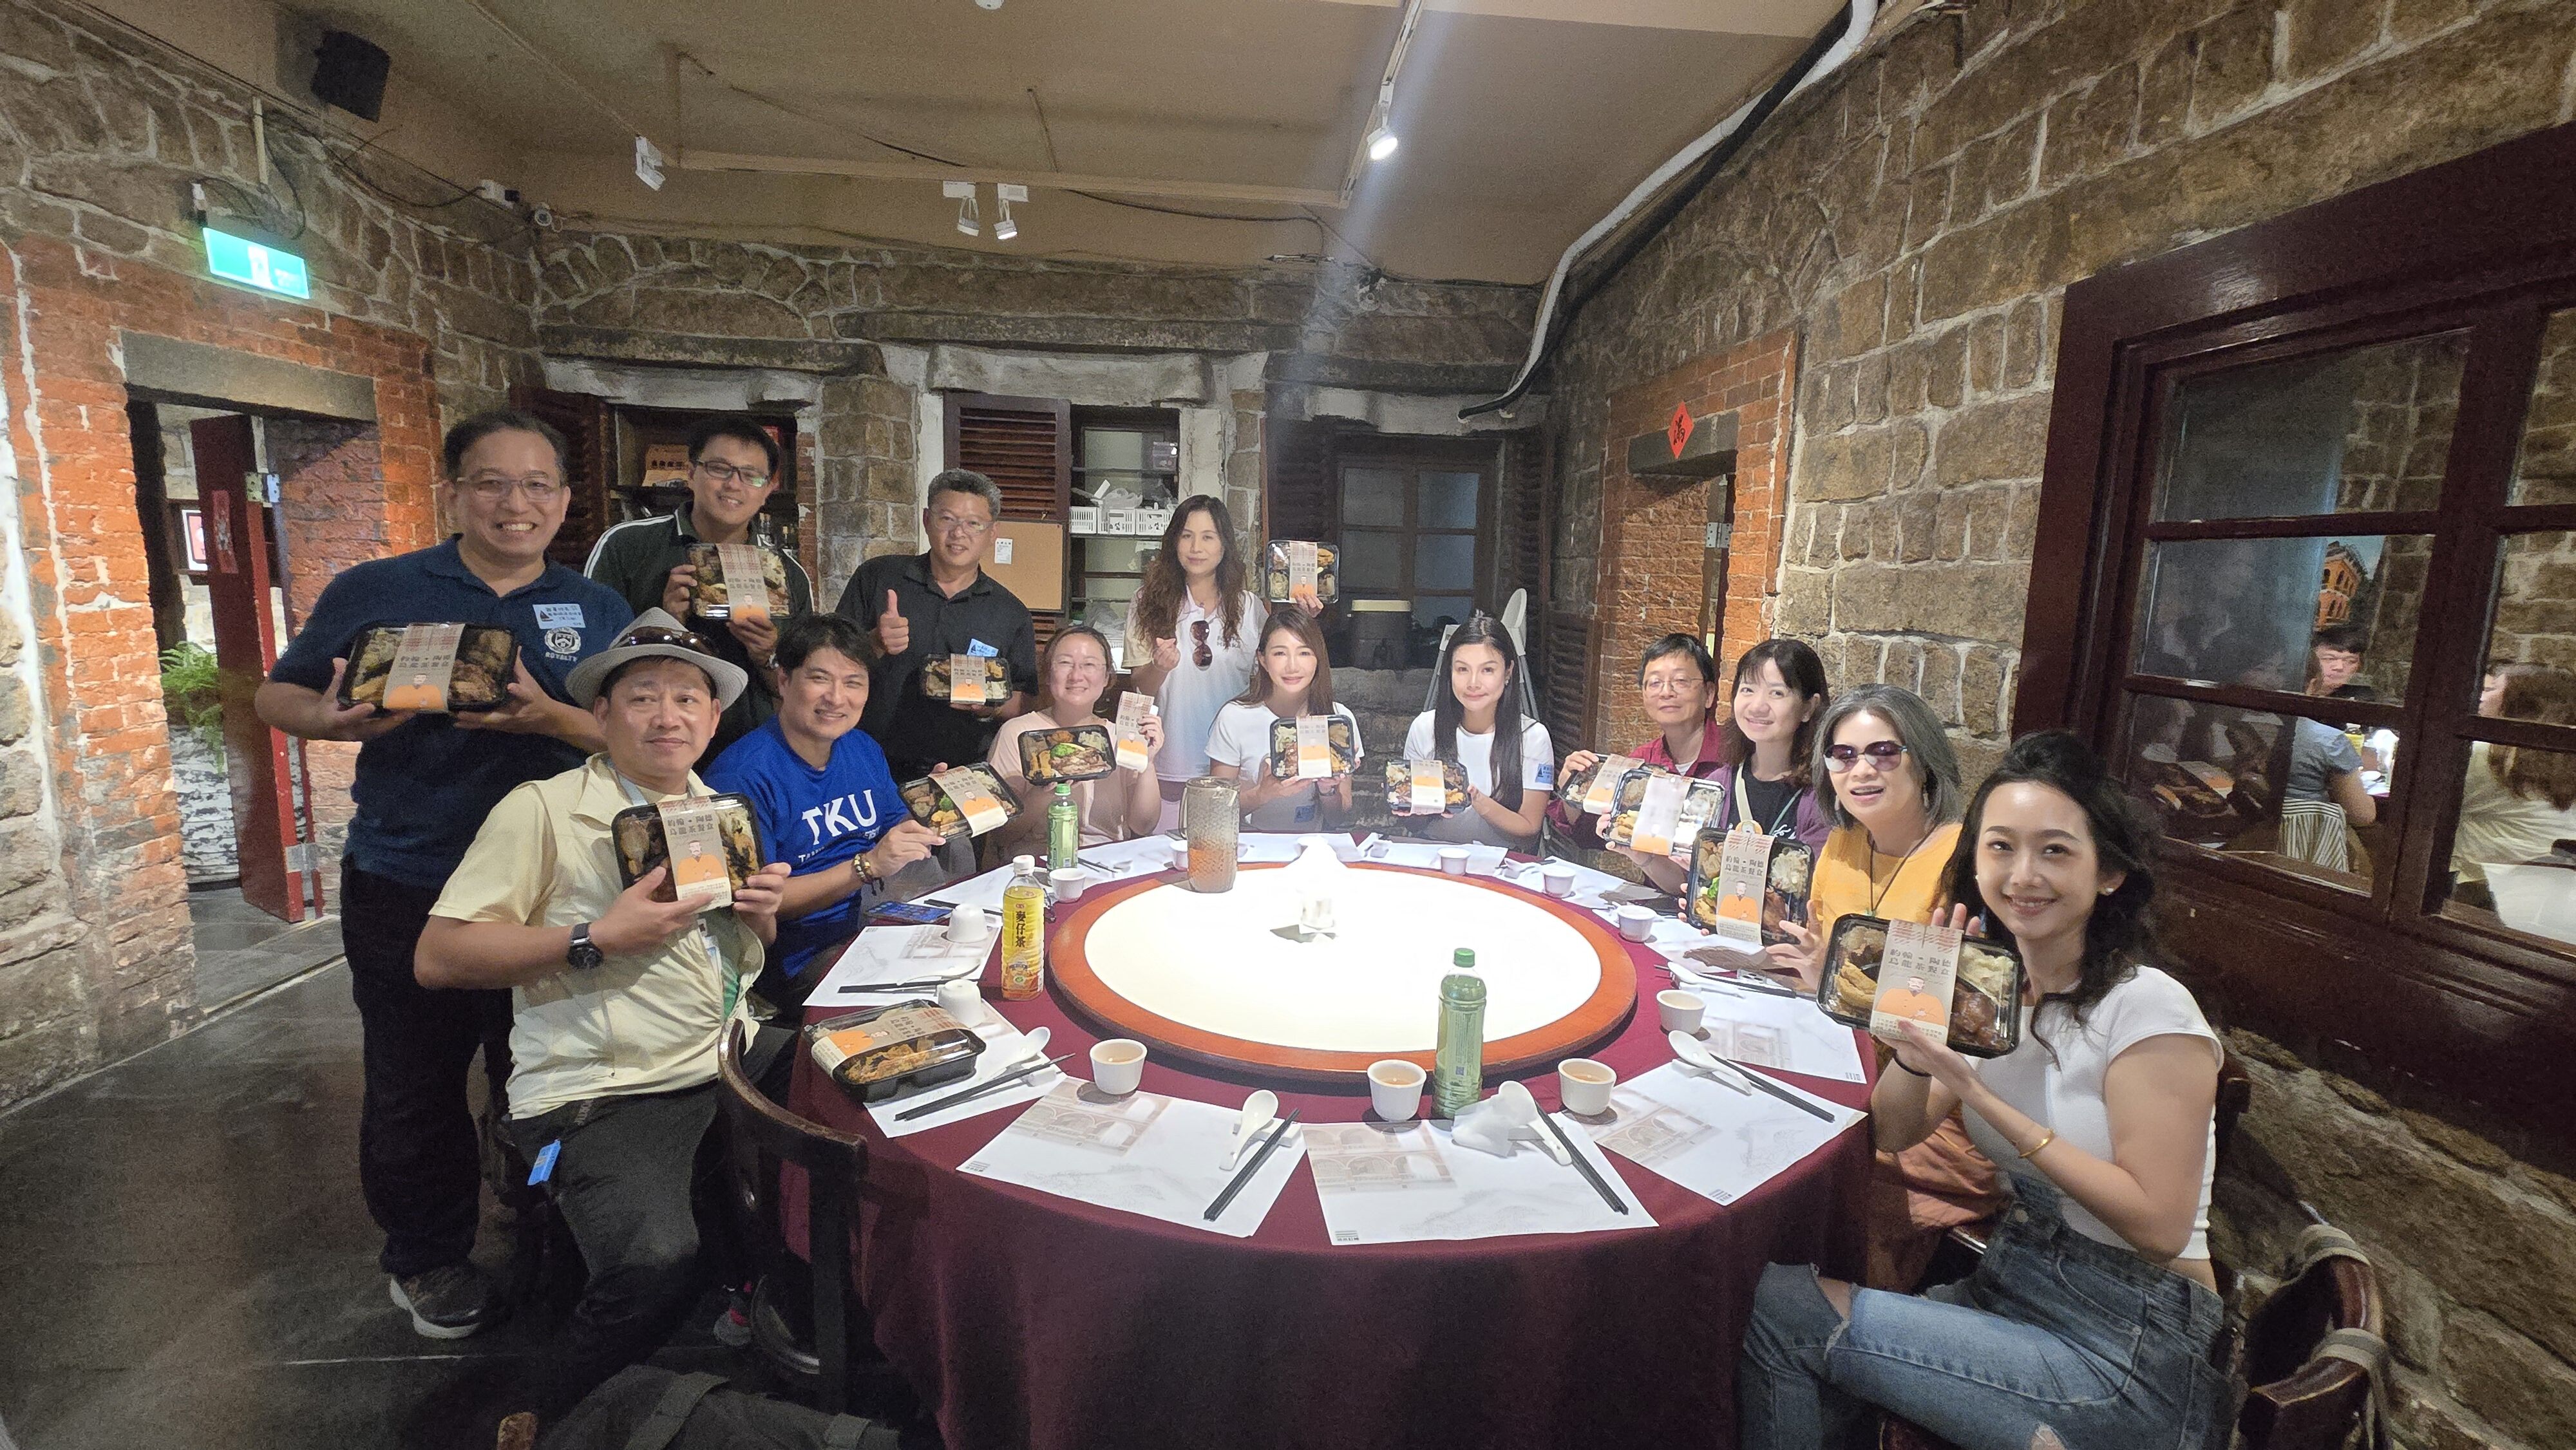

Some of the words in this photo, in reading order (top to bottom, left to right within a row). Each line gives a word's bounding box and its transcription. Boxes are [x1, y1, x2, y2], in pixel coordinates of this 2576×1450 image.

[802, 789, 876, 845] TKU
[1016, 911, 1027, 948] 麥仔茶
